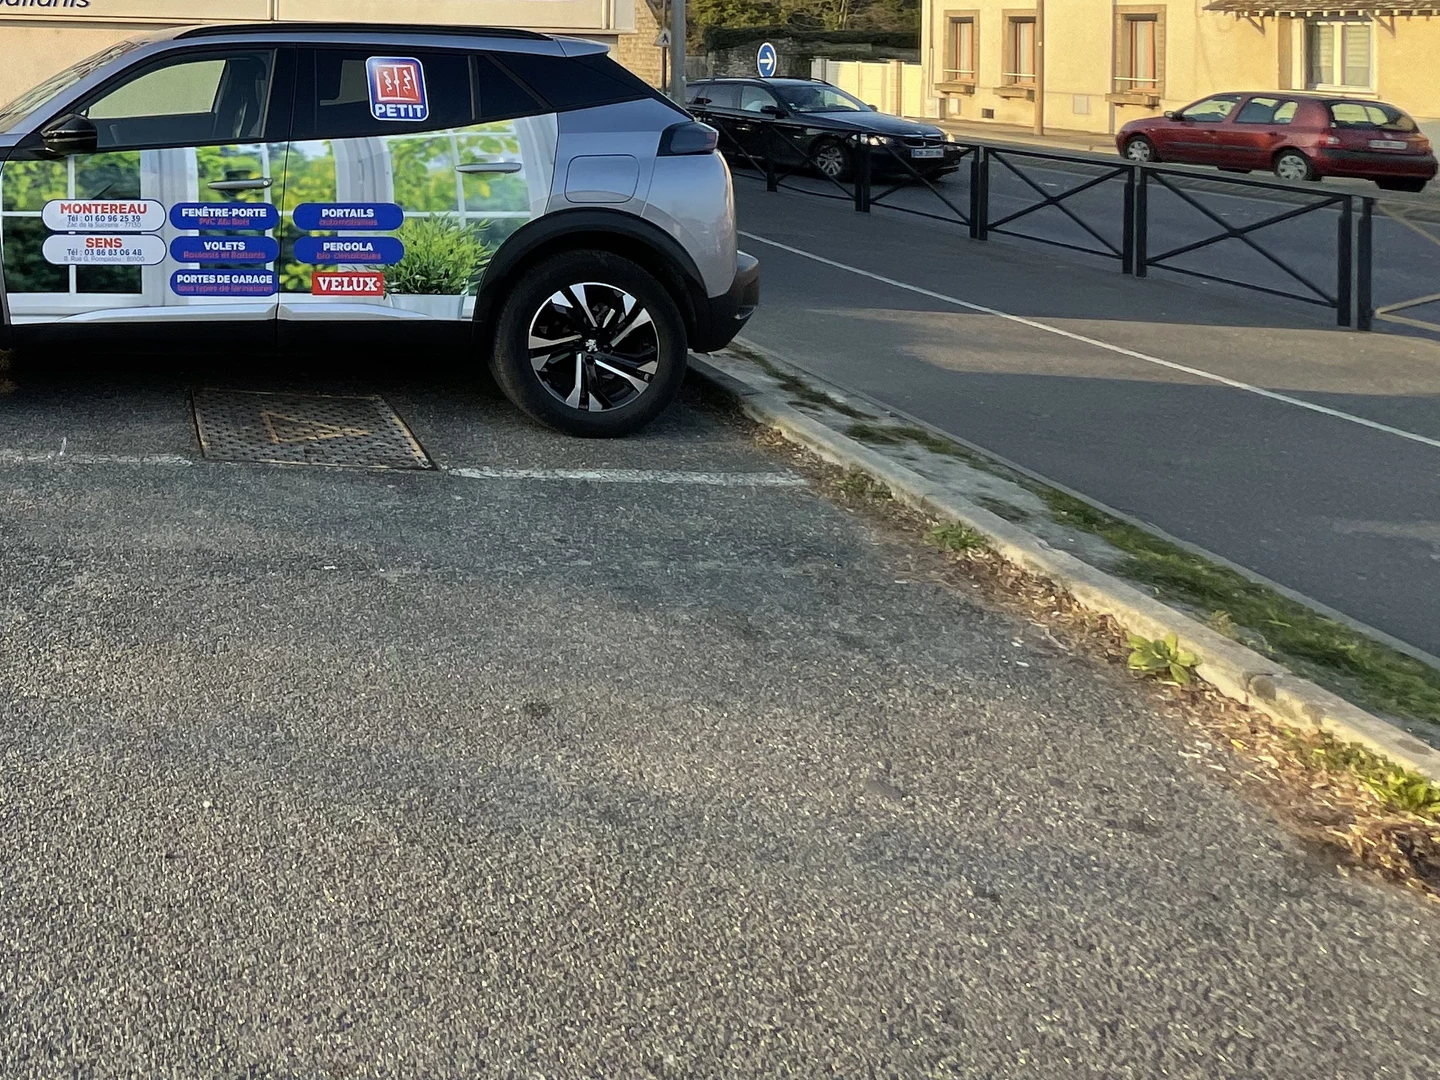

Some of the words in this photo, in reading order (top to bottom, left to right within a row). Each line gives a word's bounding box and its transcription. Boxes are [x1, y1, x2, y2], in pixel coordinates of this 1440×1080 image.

[374, 103, 424, 118] PETIT
[60, 203, 148, 214] MONTEREAU
[181, 207, 267, 217] FENÊTRE-PORTE
[321, 208, 375, 218] PORTAILS
[85, 237, 123, 248] SENS
[203, 241, 246, 251] VOLETS
[322, 242, 374, 252] PERGOLA
[176, 274, 216, 284] PORTES
[217, 274, 231, 284] DE
[231, 274, 273, 284] GARAGE
[317, 276, 378, 291] VELUX
